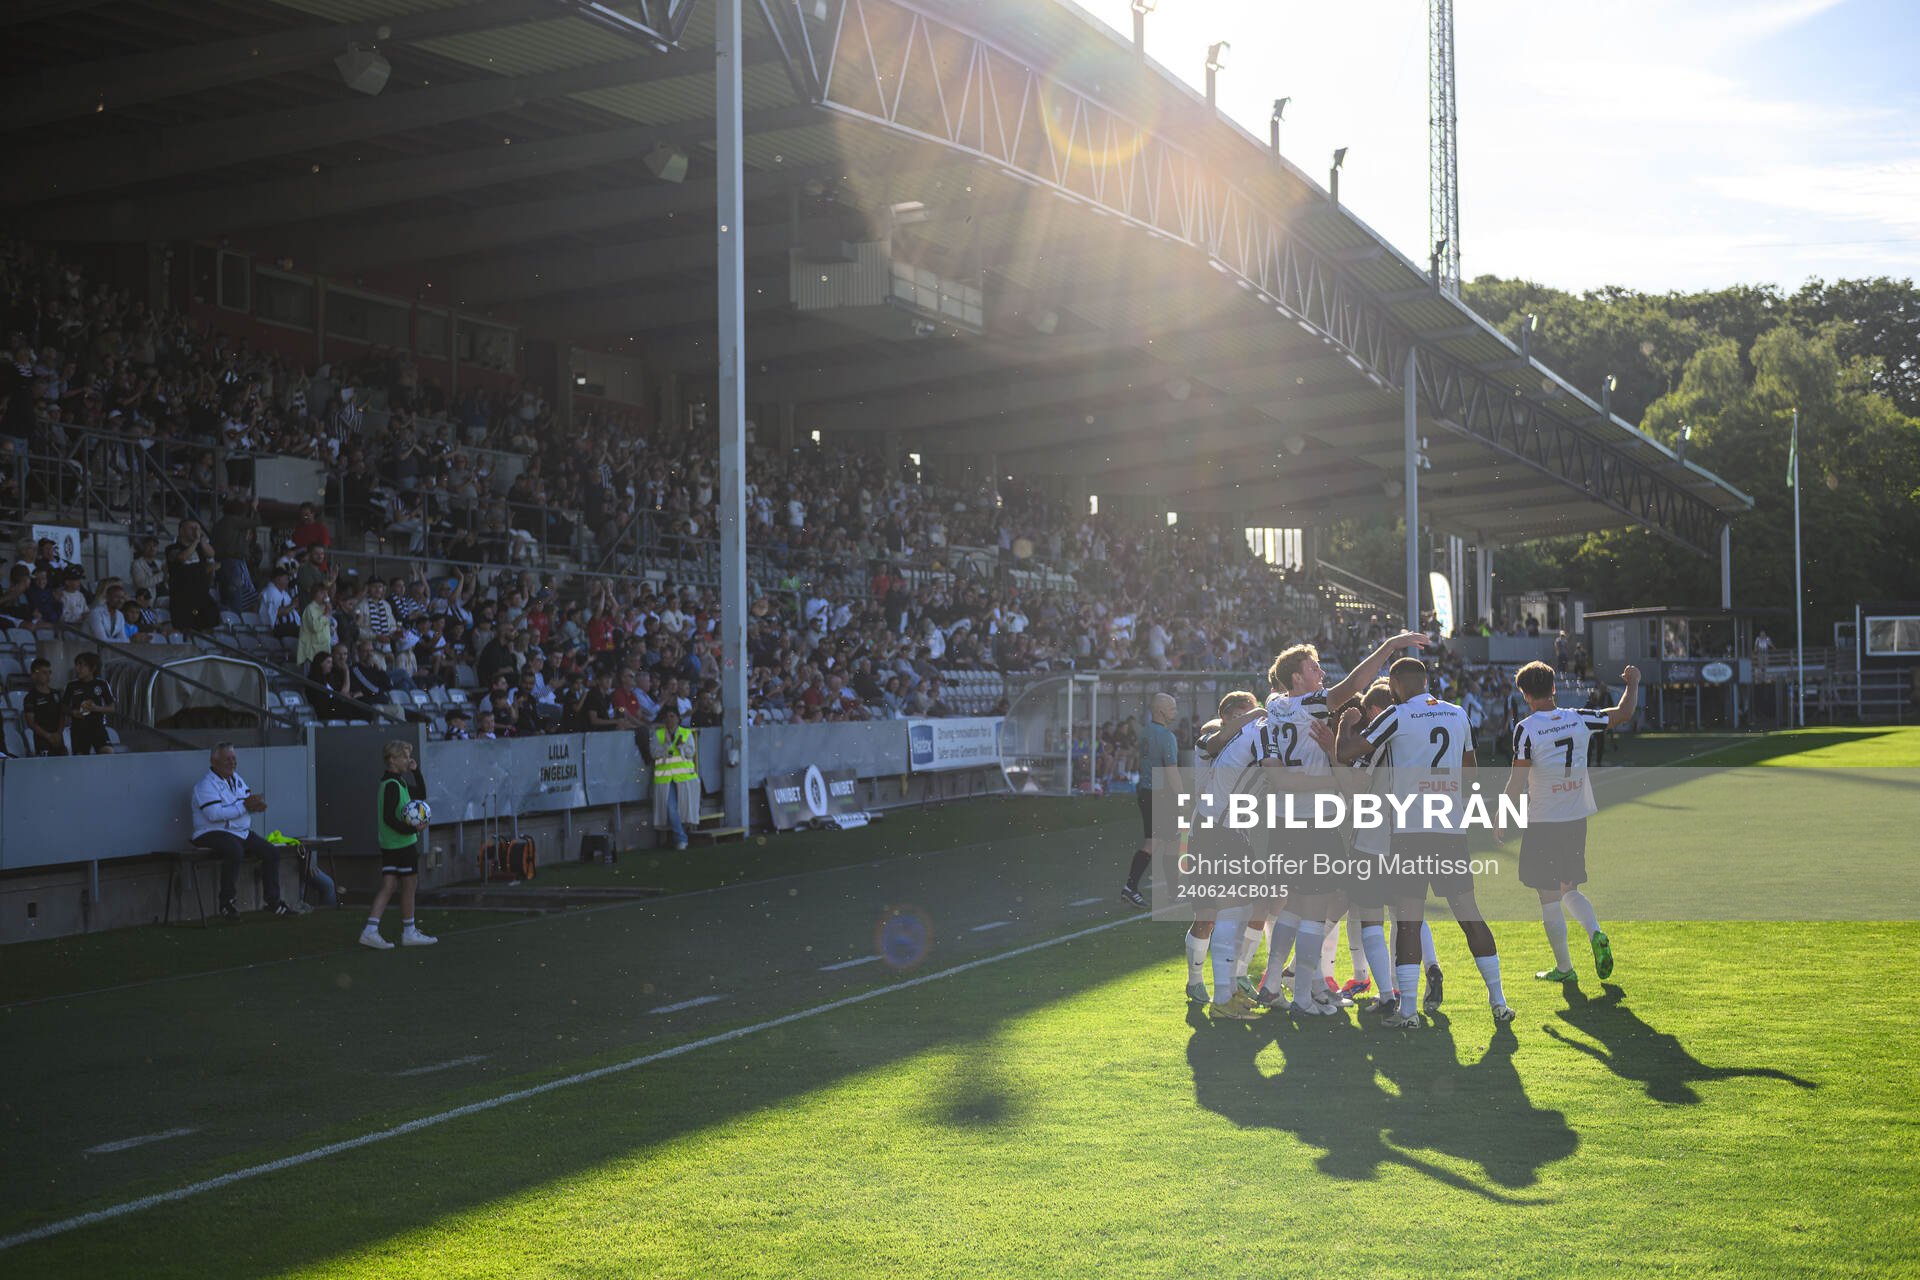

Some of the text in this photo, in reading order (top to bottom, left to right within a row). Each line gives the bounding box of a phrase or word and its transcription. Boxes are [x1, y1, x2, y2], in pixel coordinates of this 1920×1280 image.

[548, 743, 569, 760] LILLA
[1430, 726, 1450, 775] 2
[1554, 736, 1574, 778] 7
[829, 780, 855, 797] UNIBET
[1418, 780, 1458, 792] PULS
[774, 786, 801, 804] UNIBET
